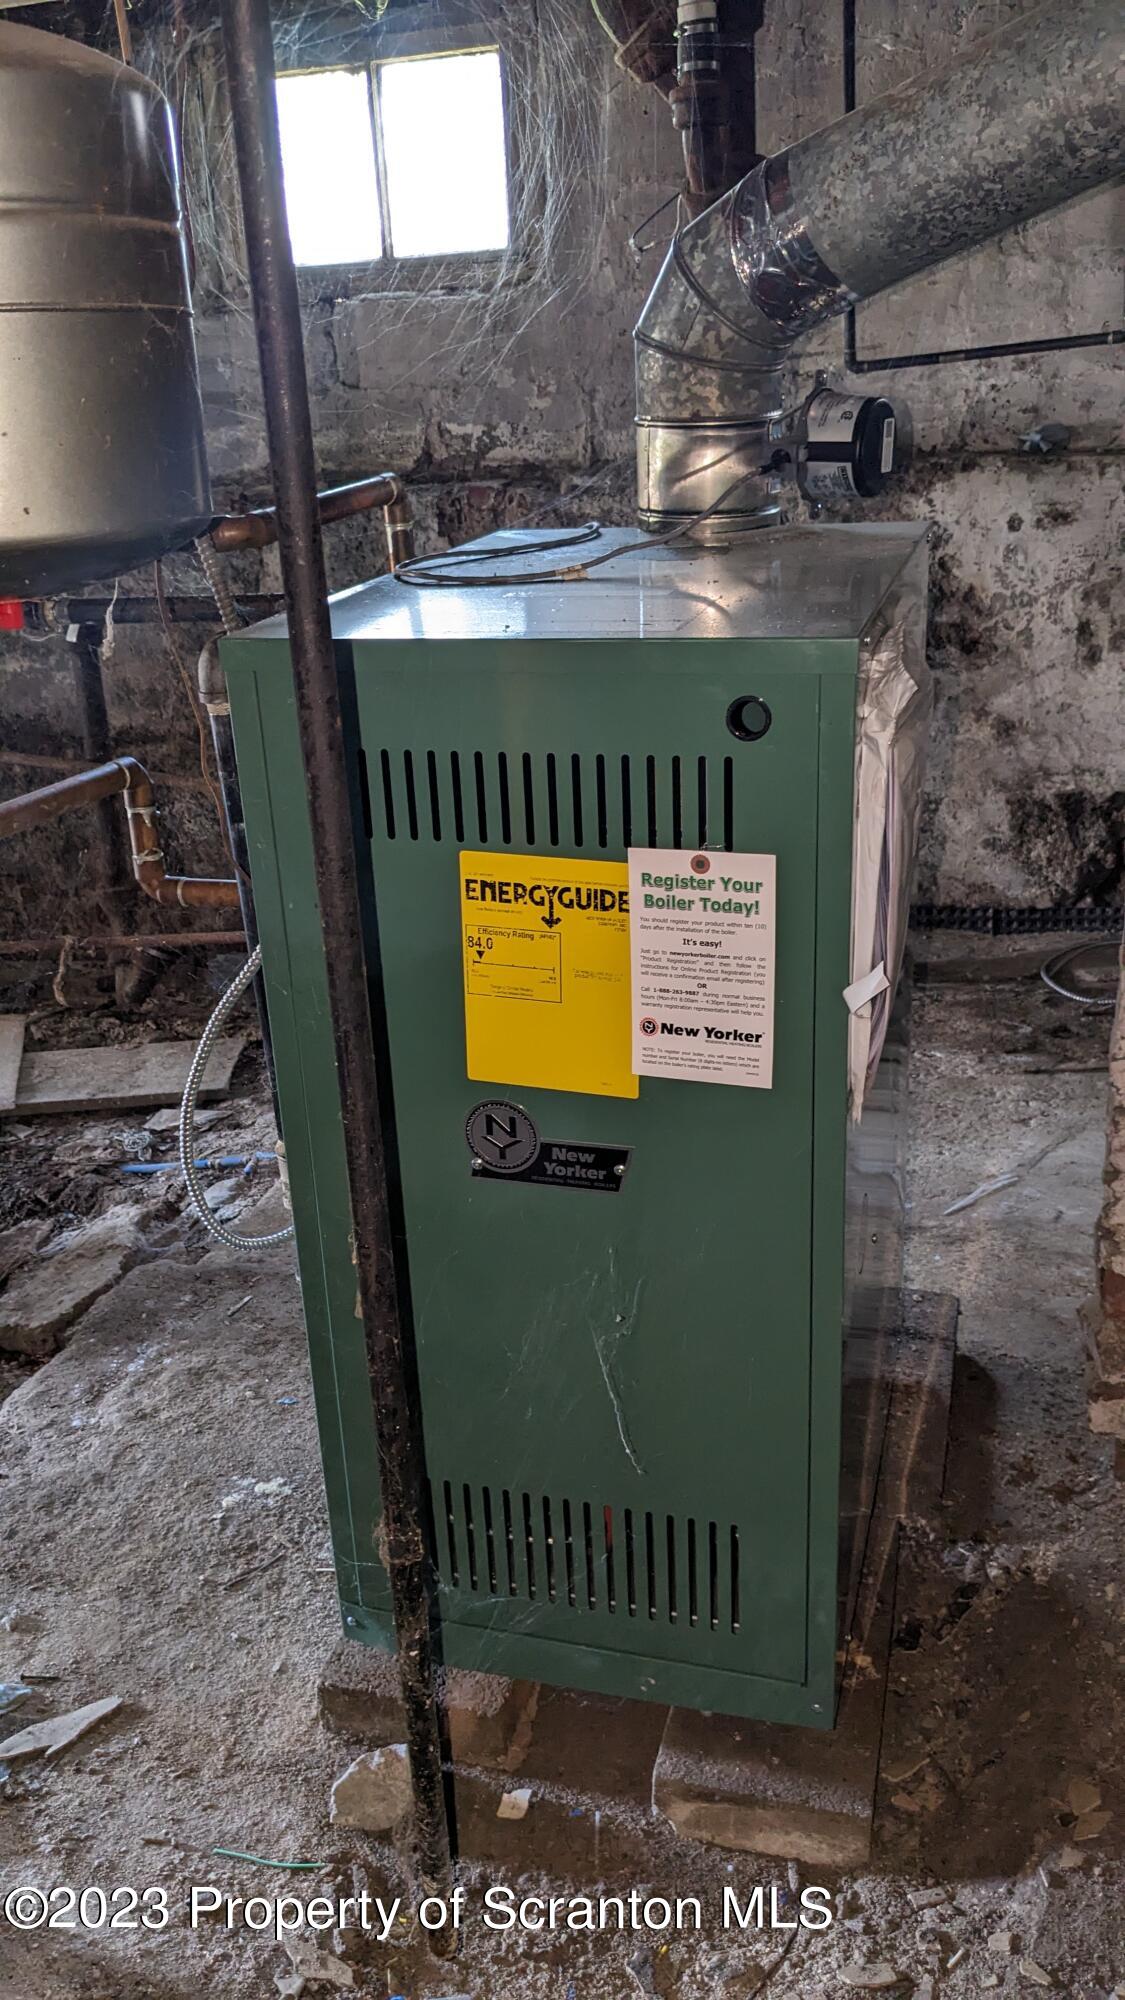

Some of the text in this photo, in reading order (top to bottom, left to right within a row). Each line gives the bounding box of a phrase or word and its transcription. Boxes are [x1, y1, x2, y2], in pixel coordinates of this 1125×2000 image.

[641, 873, 715, 891] Register
[720, 877, 763, 893] Your
[465, 879, 629, 915] ENERGYGUIDE
[644, 894, 759, 917] Boiler Today!
[478, 928, 510, 938] Efficiency
[513, 931, 534, 941] Rating
[467, 936, 493, 949] 84.0
[699, 940, 722, 948] easy!
[670, 951, 730, 959] newyorkerboiler.com
[721, 969, 751, 977] Registration
[694, 1006, 729, 1014] representative
[661, 1023, 762, 1043] New Yorker
[552, 1147, 596, 1163] New
[544, 1162, 606, 1179] Yorker
